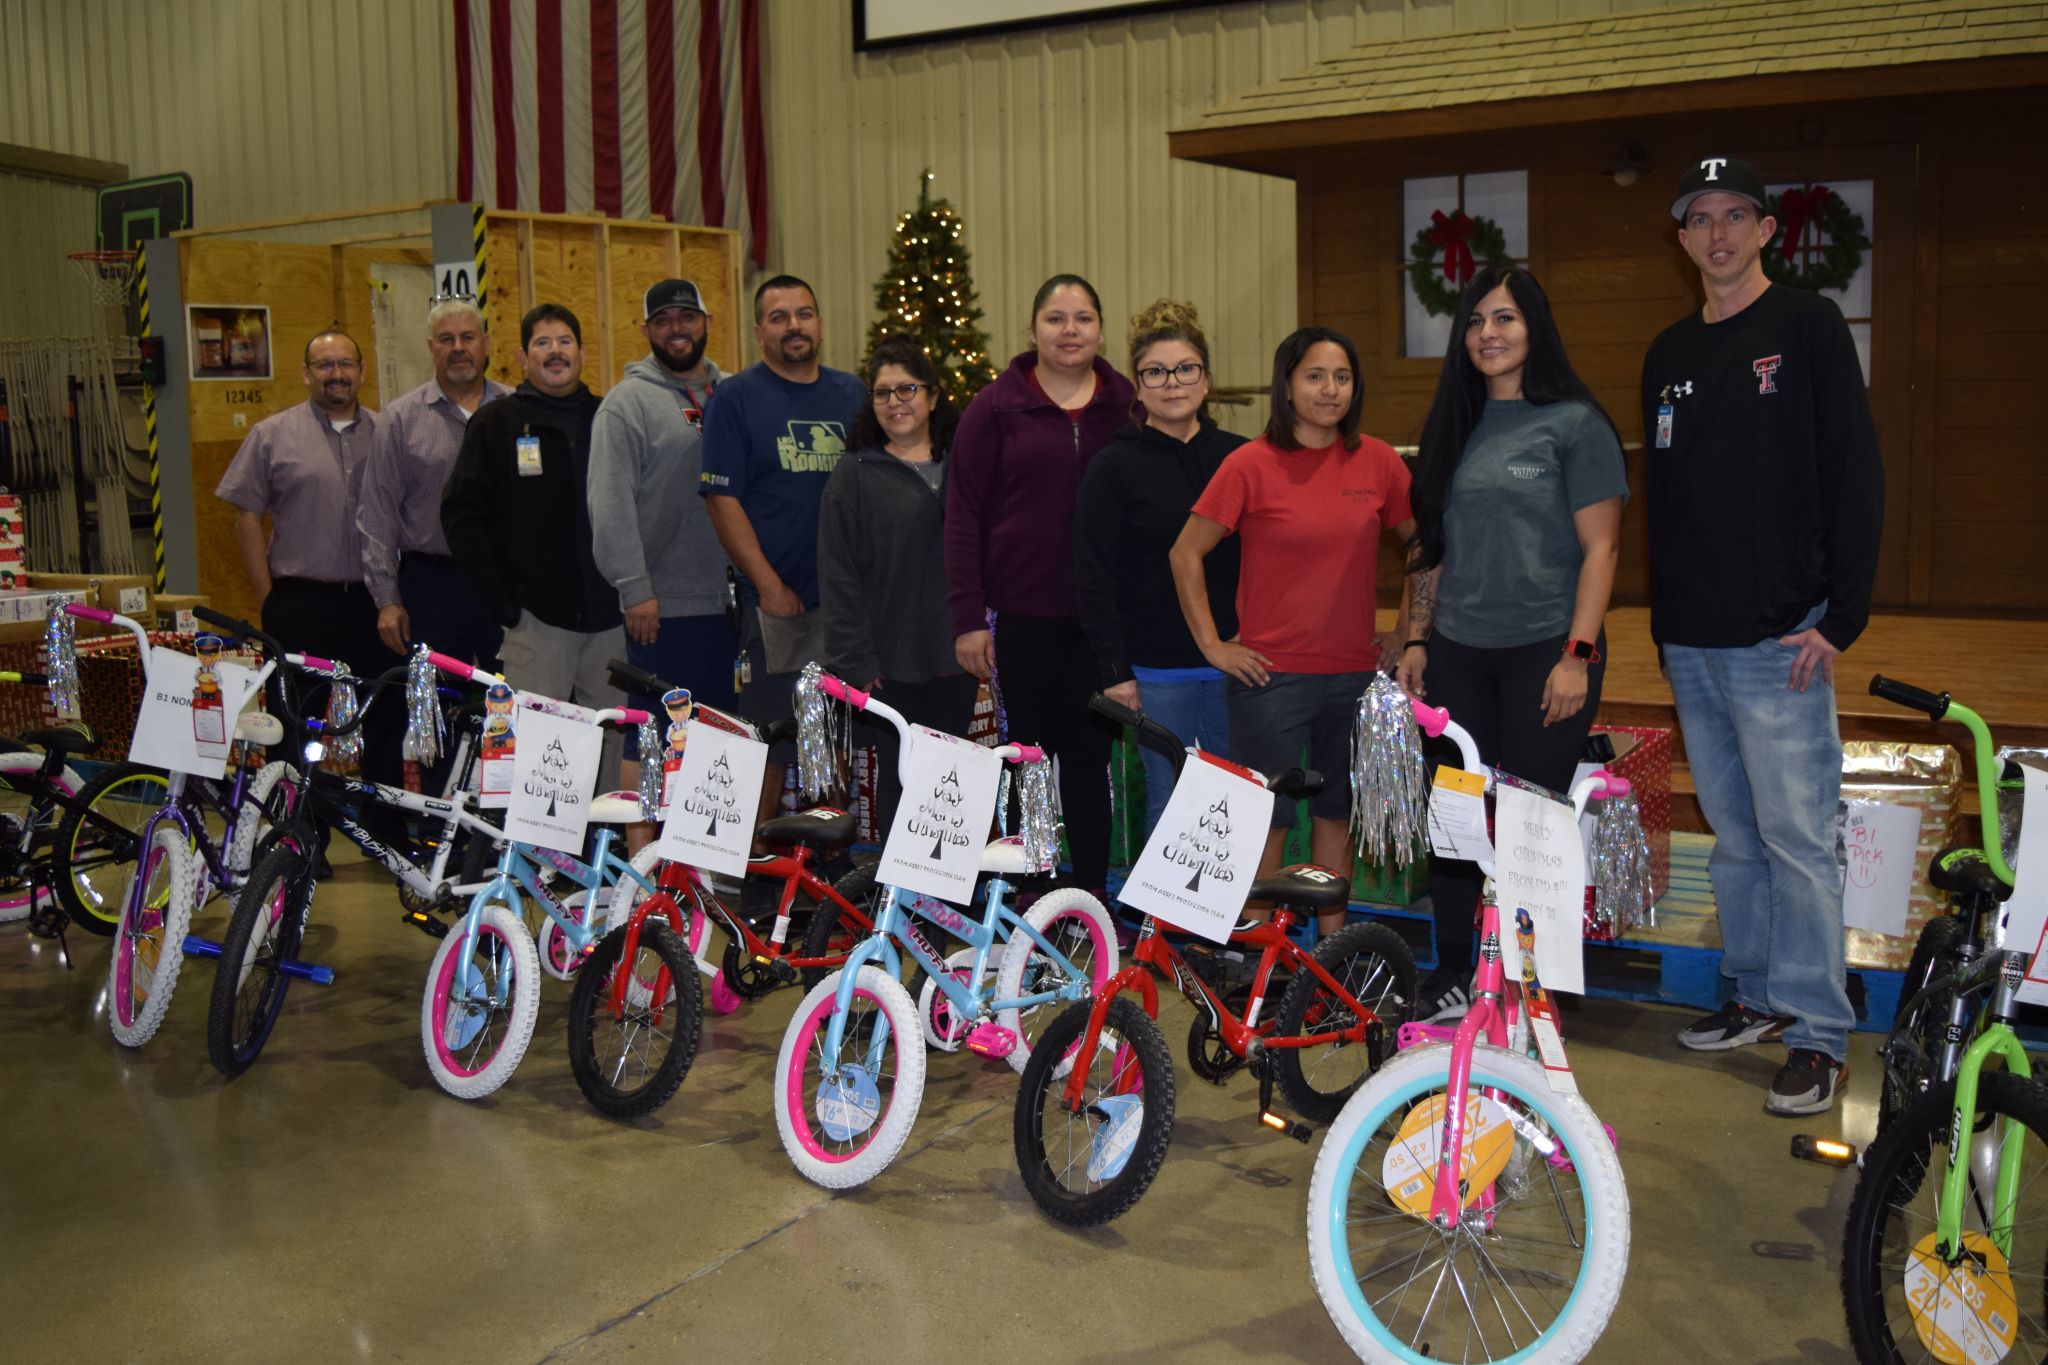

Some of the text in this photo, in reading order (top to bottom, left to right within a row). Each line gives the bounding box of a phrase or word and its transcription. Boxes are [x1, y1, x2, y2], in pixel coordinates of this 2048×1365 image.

[1700, 158, 1727, 181] T
[442, 268, 470, 297] 10
[225, 389, 263, 405] 12345
[156, 692, 169, 703] B1
[806, 809, 840, 821] 16
[343, 816, 389, 858] AMBUSH
[1293, 867, 1337, 884] 16
[1508, 870, 1534, 889] FROM
[538, 883, 577, 920] HUFFY
[1141, 881, 1226, 920] FROM ASSET PROTECTION TEAM
[910, 929, 951, 974] HUFFY
[1949, 1108, 1962, 1167] HUFFY
